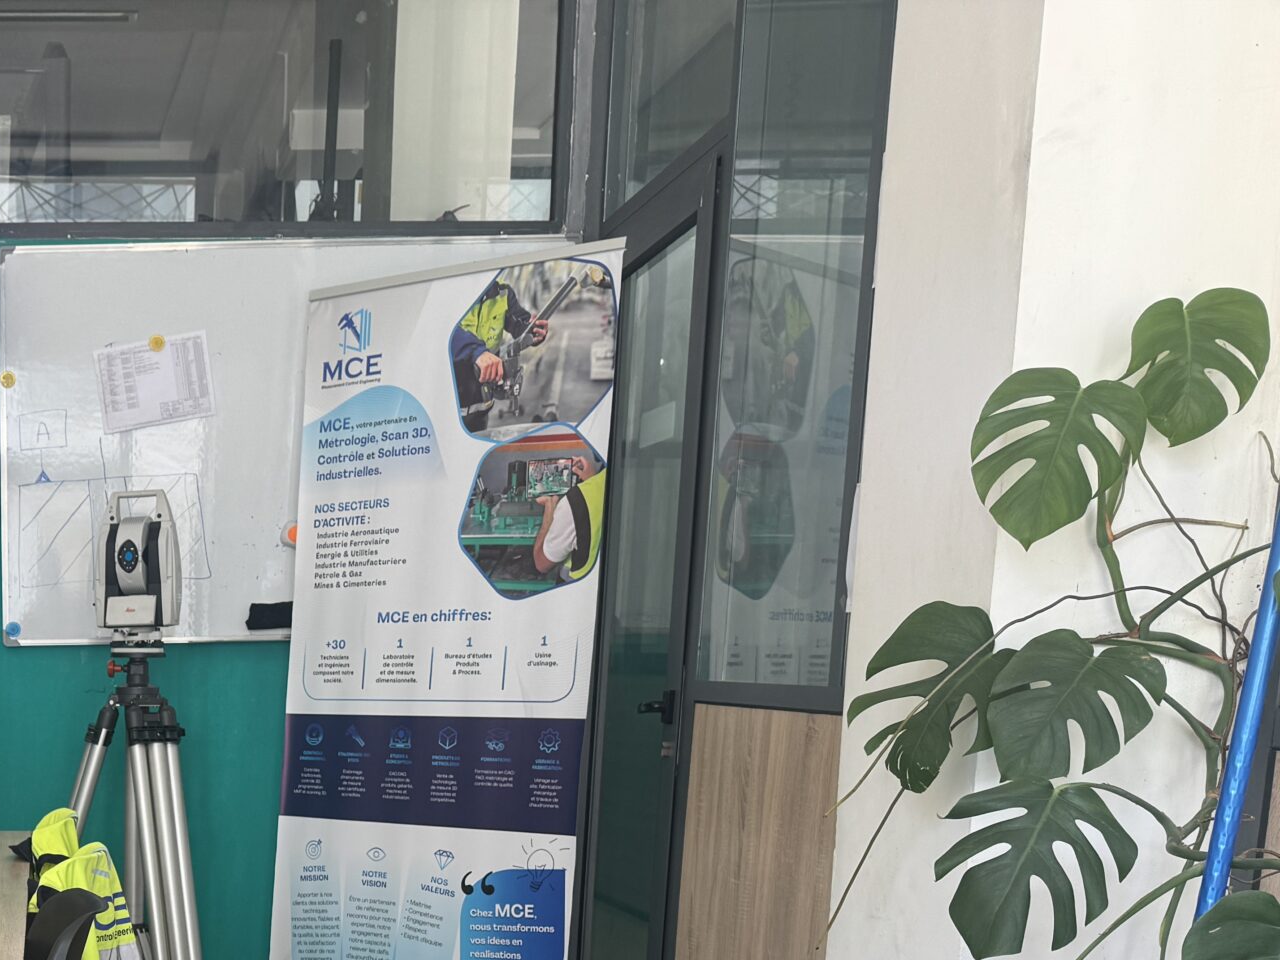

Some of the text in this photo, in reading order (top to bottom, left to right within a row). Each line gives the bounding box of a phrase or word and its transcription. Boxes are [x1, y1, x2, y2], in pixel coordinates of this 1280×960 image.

[322, 353, 382, 383] MCE
[319, 417, 354, 433] MCE,
[355, 420, 373, 429] votre
[373, 416, 408, 428] partenaire
[35, 420, 51, 441] A
[380, 430, 409, 442] Scan
[411, 427, 431, 439] 3D,
[317, 445, 431, 465] Contrôle et Solutions
[316, 466, 382, 482] industrielles.
[314, 498, 390, 514] NOS SECTEURS
[316, 531, 349, 539] Industrie
[316, 538, 390, 549] Industrie Ferroviaire
[314, 561, 347, 569] Industrie
[349, 570, 363, 578] Gaz
[342, 579, 387, 588] Cimenteries
[377, 609, 492, 624] MCE en chiffres:
[325, 639, 346, 650] +30
[396, 638, 404, 649] 1
[465, 637, 473, 648] 1
[540, 635, 548, 646] 1
[303, 865, 326, 873] NOTRE
[361, 870, 388, 879] NOTRE
[361, 879, 387, 888] VISION
[430, 876, 449, 887] NOS
[420, 883, 456, 898] VALEURS
[469, 903, 537, 920] Chez MCE,
[469, 923, 555, 933] nous transformons
[469, 937, 486, 945] vos
[512, 938, 523, 946] en
